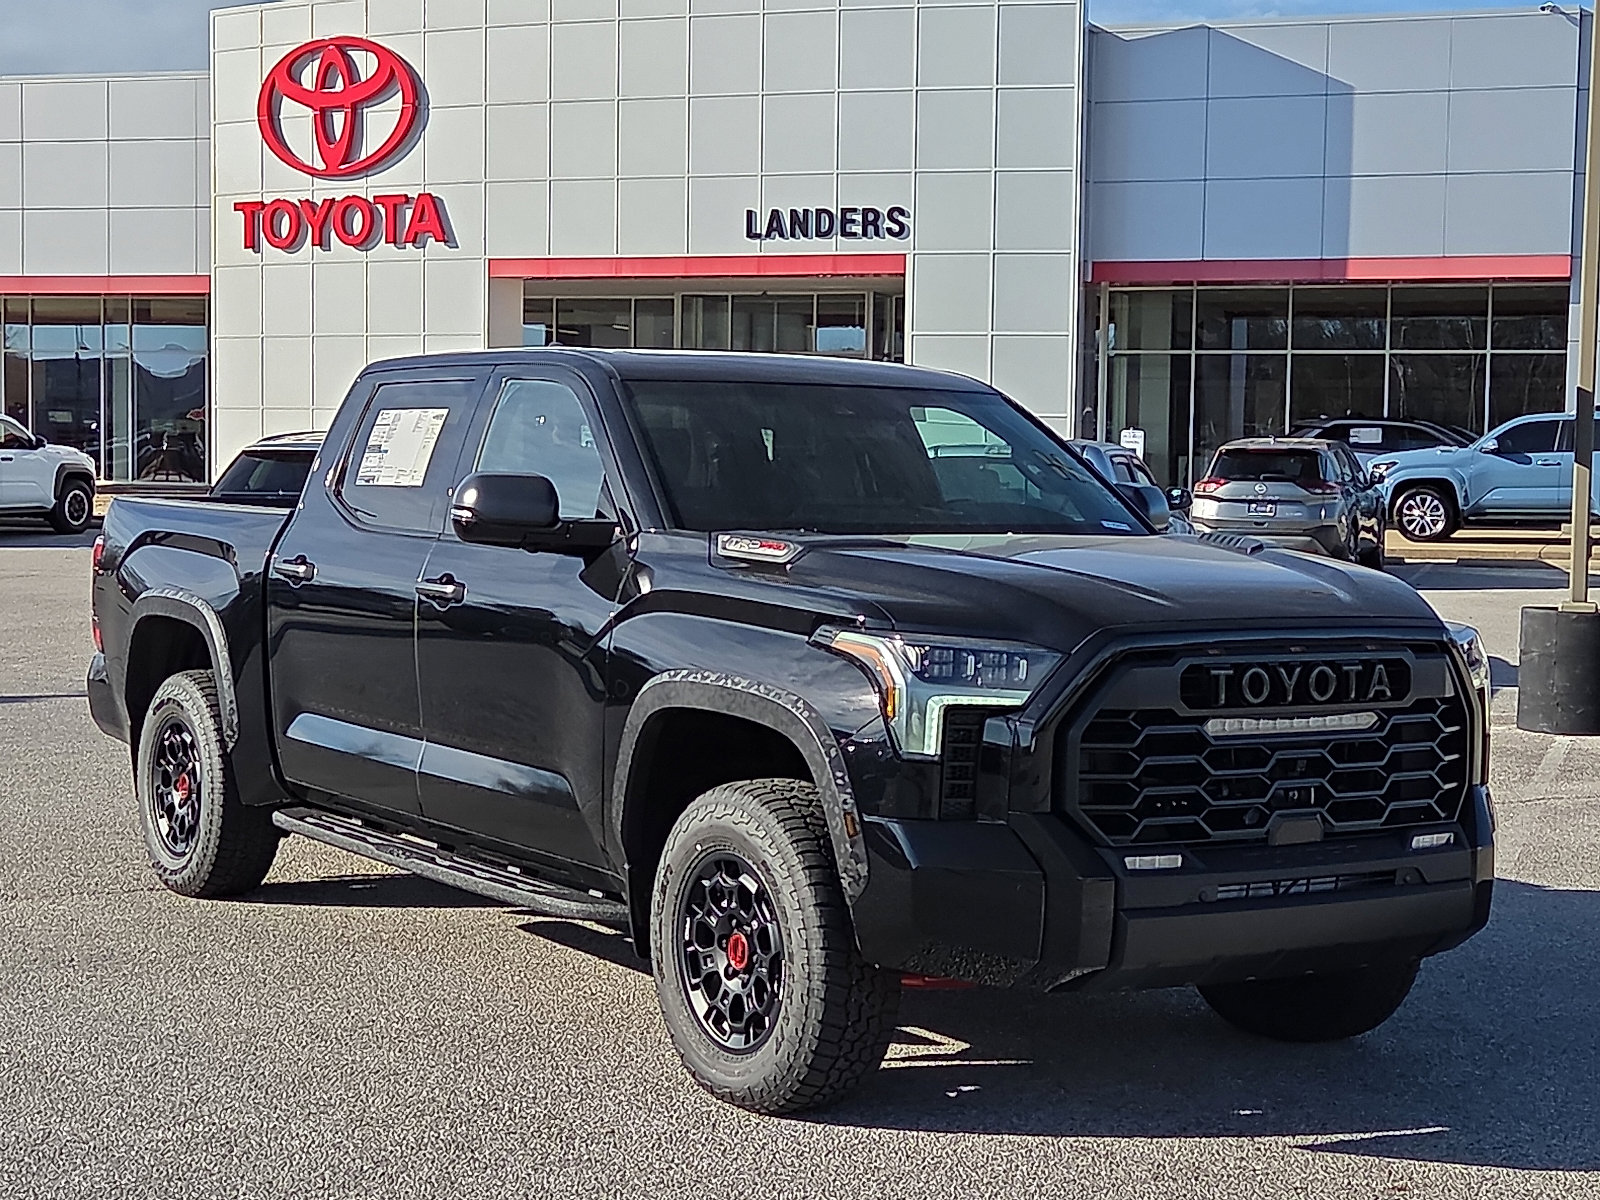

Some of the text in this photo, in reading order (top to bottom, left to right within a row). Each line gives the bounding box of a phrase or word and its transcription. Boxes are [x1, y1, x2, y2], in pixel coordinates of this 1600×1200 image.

[234, 193, 449, 250] TOYOTA
[746, 206, 909, 239] LANDERS
[1209, 664, 1392, 706] TOYOTA
